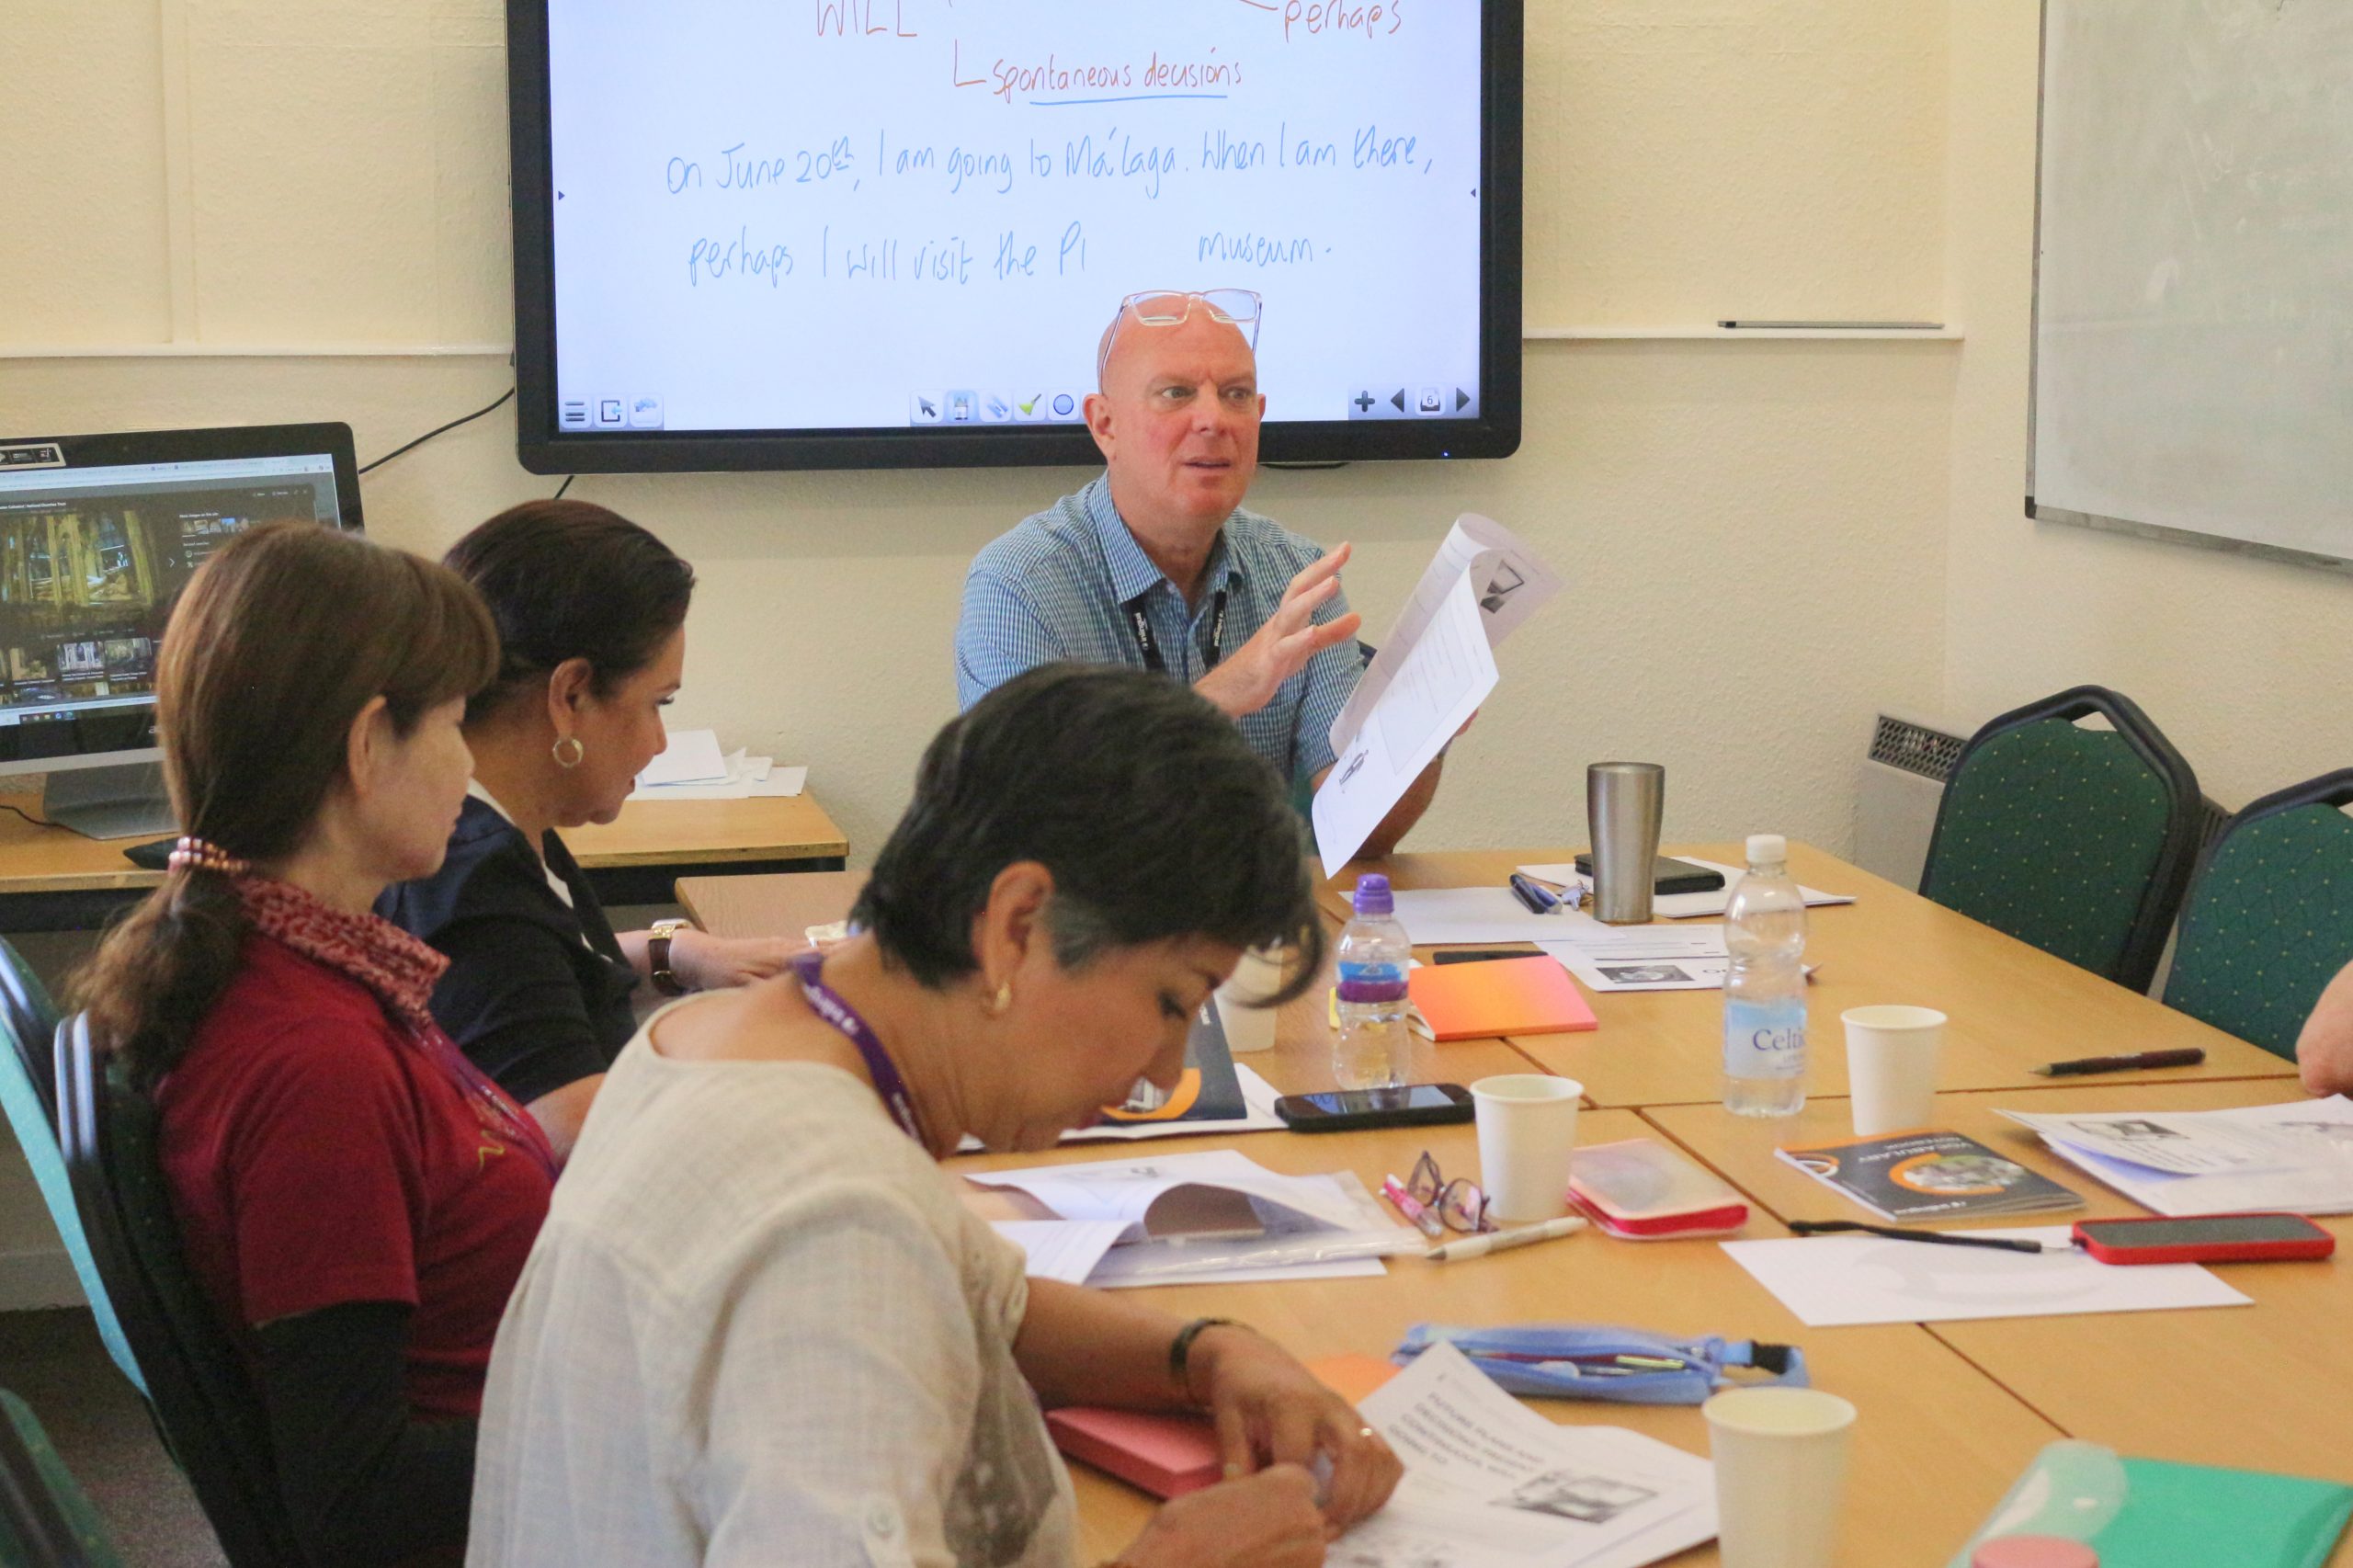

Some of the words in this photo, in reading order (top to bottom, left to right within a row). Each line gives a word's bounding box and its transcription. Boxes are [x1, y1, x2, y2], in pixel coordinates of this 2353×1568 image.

[817, 0, 917, 37] WILL
[1284, 0, 1401, 42] perhaps
[993, 53, 1131, 104] spontaneous
[667, 157, 702, 194] On
[716, 142, 785, 188] June
[897, 147, 935, 175] am
[948, 147, 1012, 194] going
[1030, 139, 1051, 176] to
[1202, 130, 1265, 170] When
[1296, 140, 1336, 165] am
[1353, 125, 1432, 175] there,
[688, 225, 793, 289] perhaps
[847, 238, 897, 279] will
[914, 236, 972, 285] visit
[994, 231, 1036, 280] the
